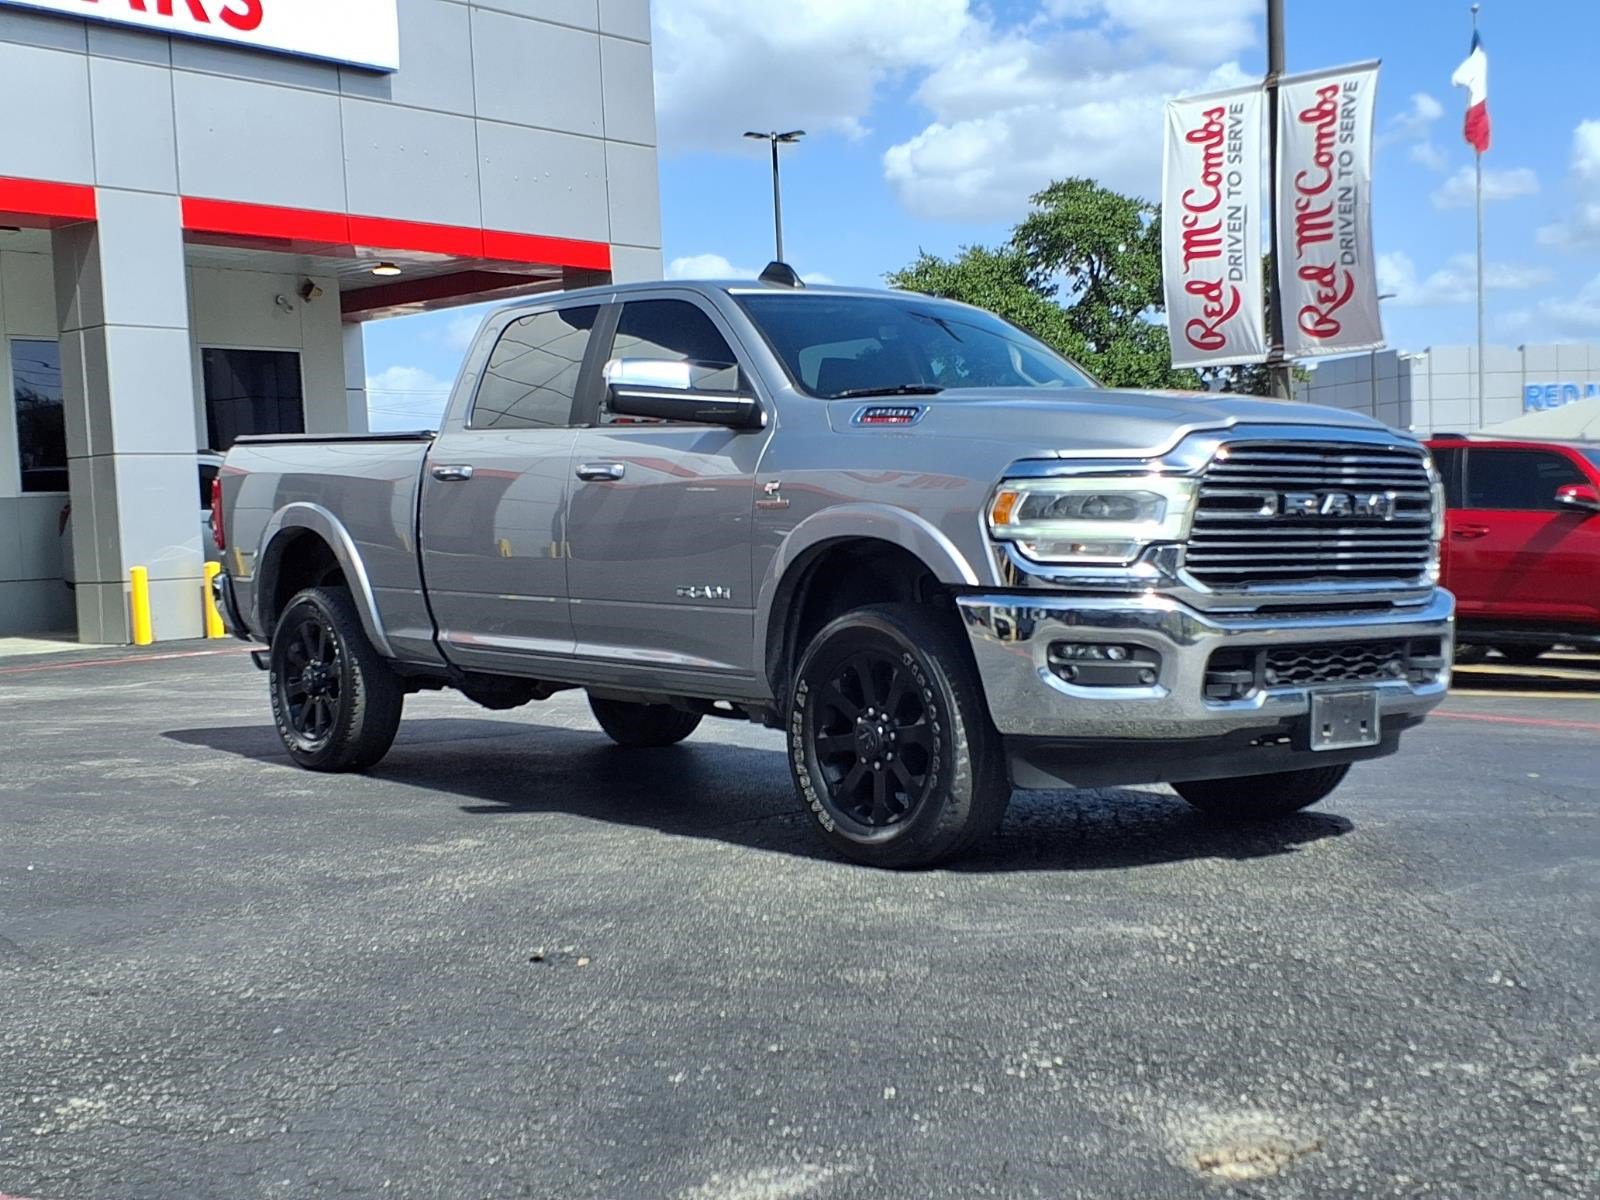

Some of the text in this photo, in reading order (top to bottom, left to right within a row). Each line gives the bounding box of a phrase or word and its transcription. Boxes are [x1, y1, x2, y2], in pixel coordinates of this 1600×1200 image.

[1227, 103, 1244, 282] DRIVEN TO SERVE
[1338, 81, 1358, 266] DRIVEN TO SERVE
[1185, 278, 1240, 350] Red
[1297, 262, 1355, 338] Red
[1284, 491, 1396, 521] RAM
